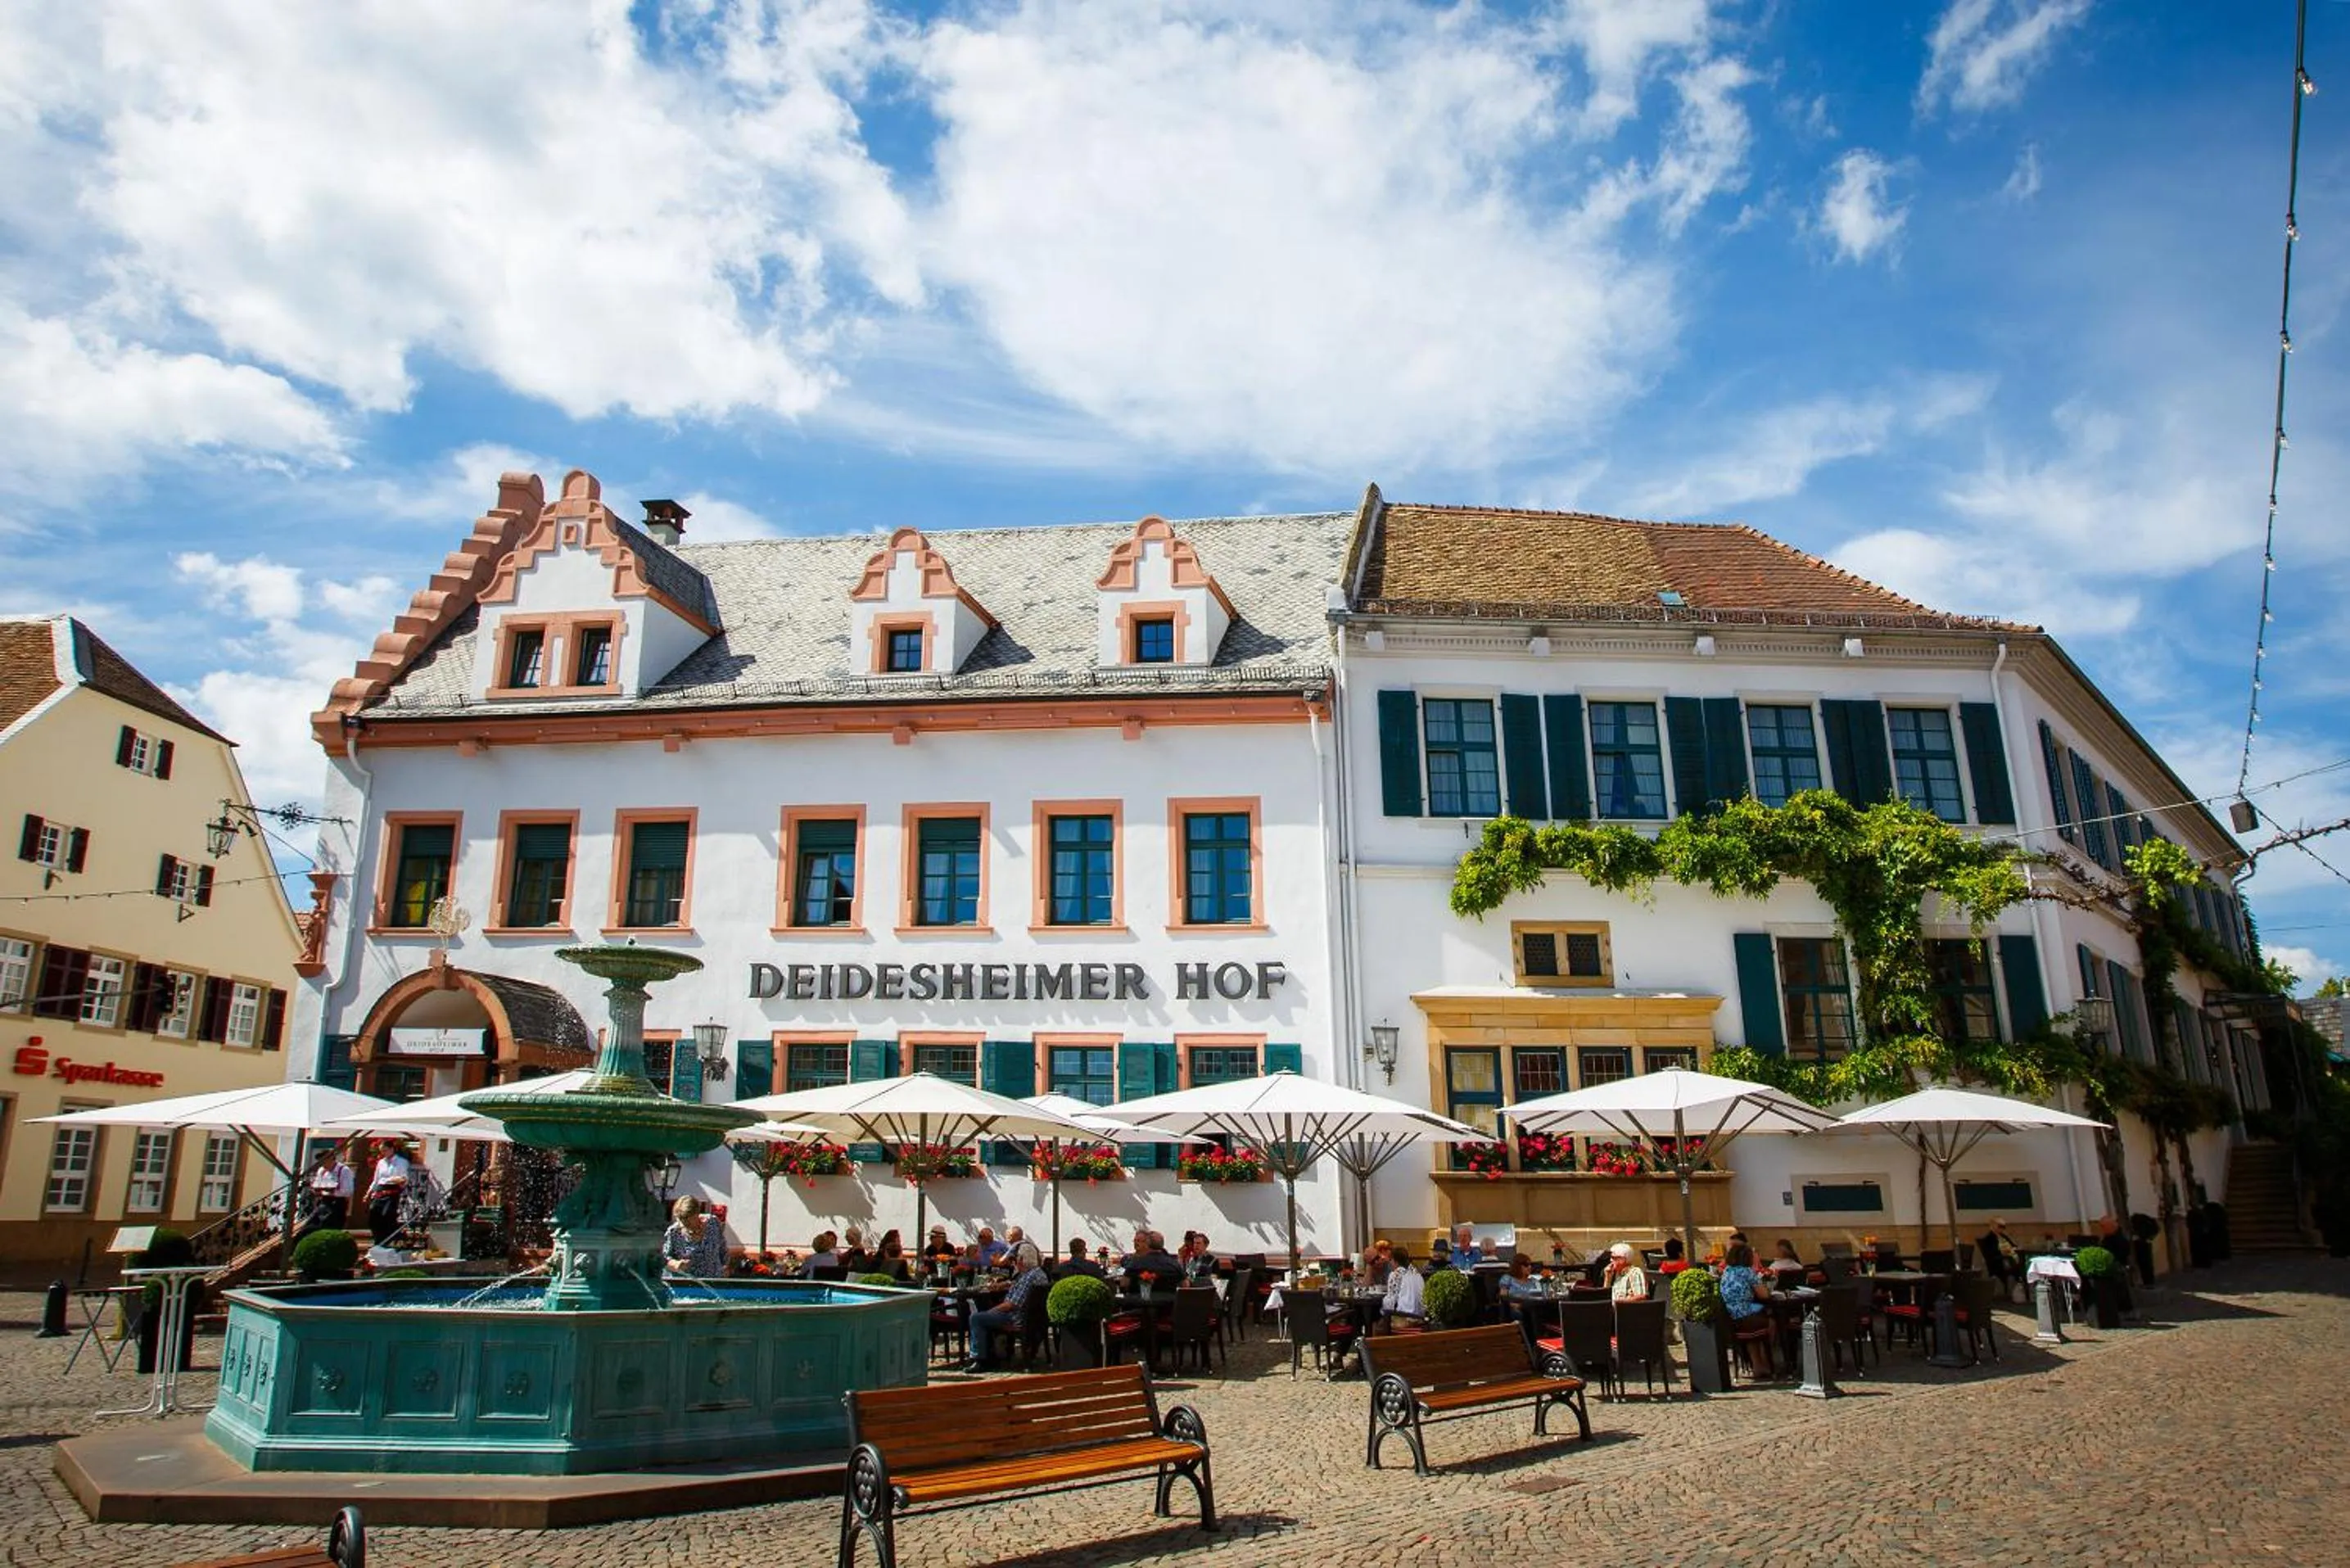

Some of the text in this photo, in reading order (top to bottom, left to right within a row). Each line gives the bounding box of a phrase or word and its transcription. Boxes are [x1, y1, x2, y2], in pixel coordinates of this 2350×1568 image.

[748, 961, 1286, 1001] DEIDESHEIMER HOF
[52, 1057, 164, 1087] Sparkasse
